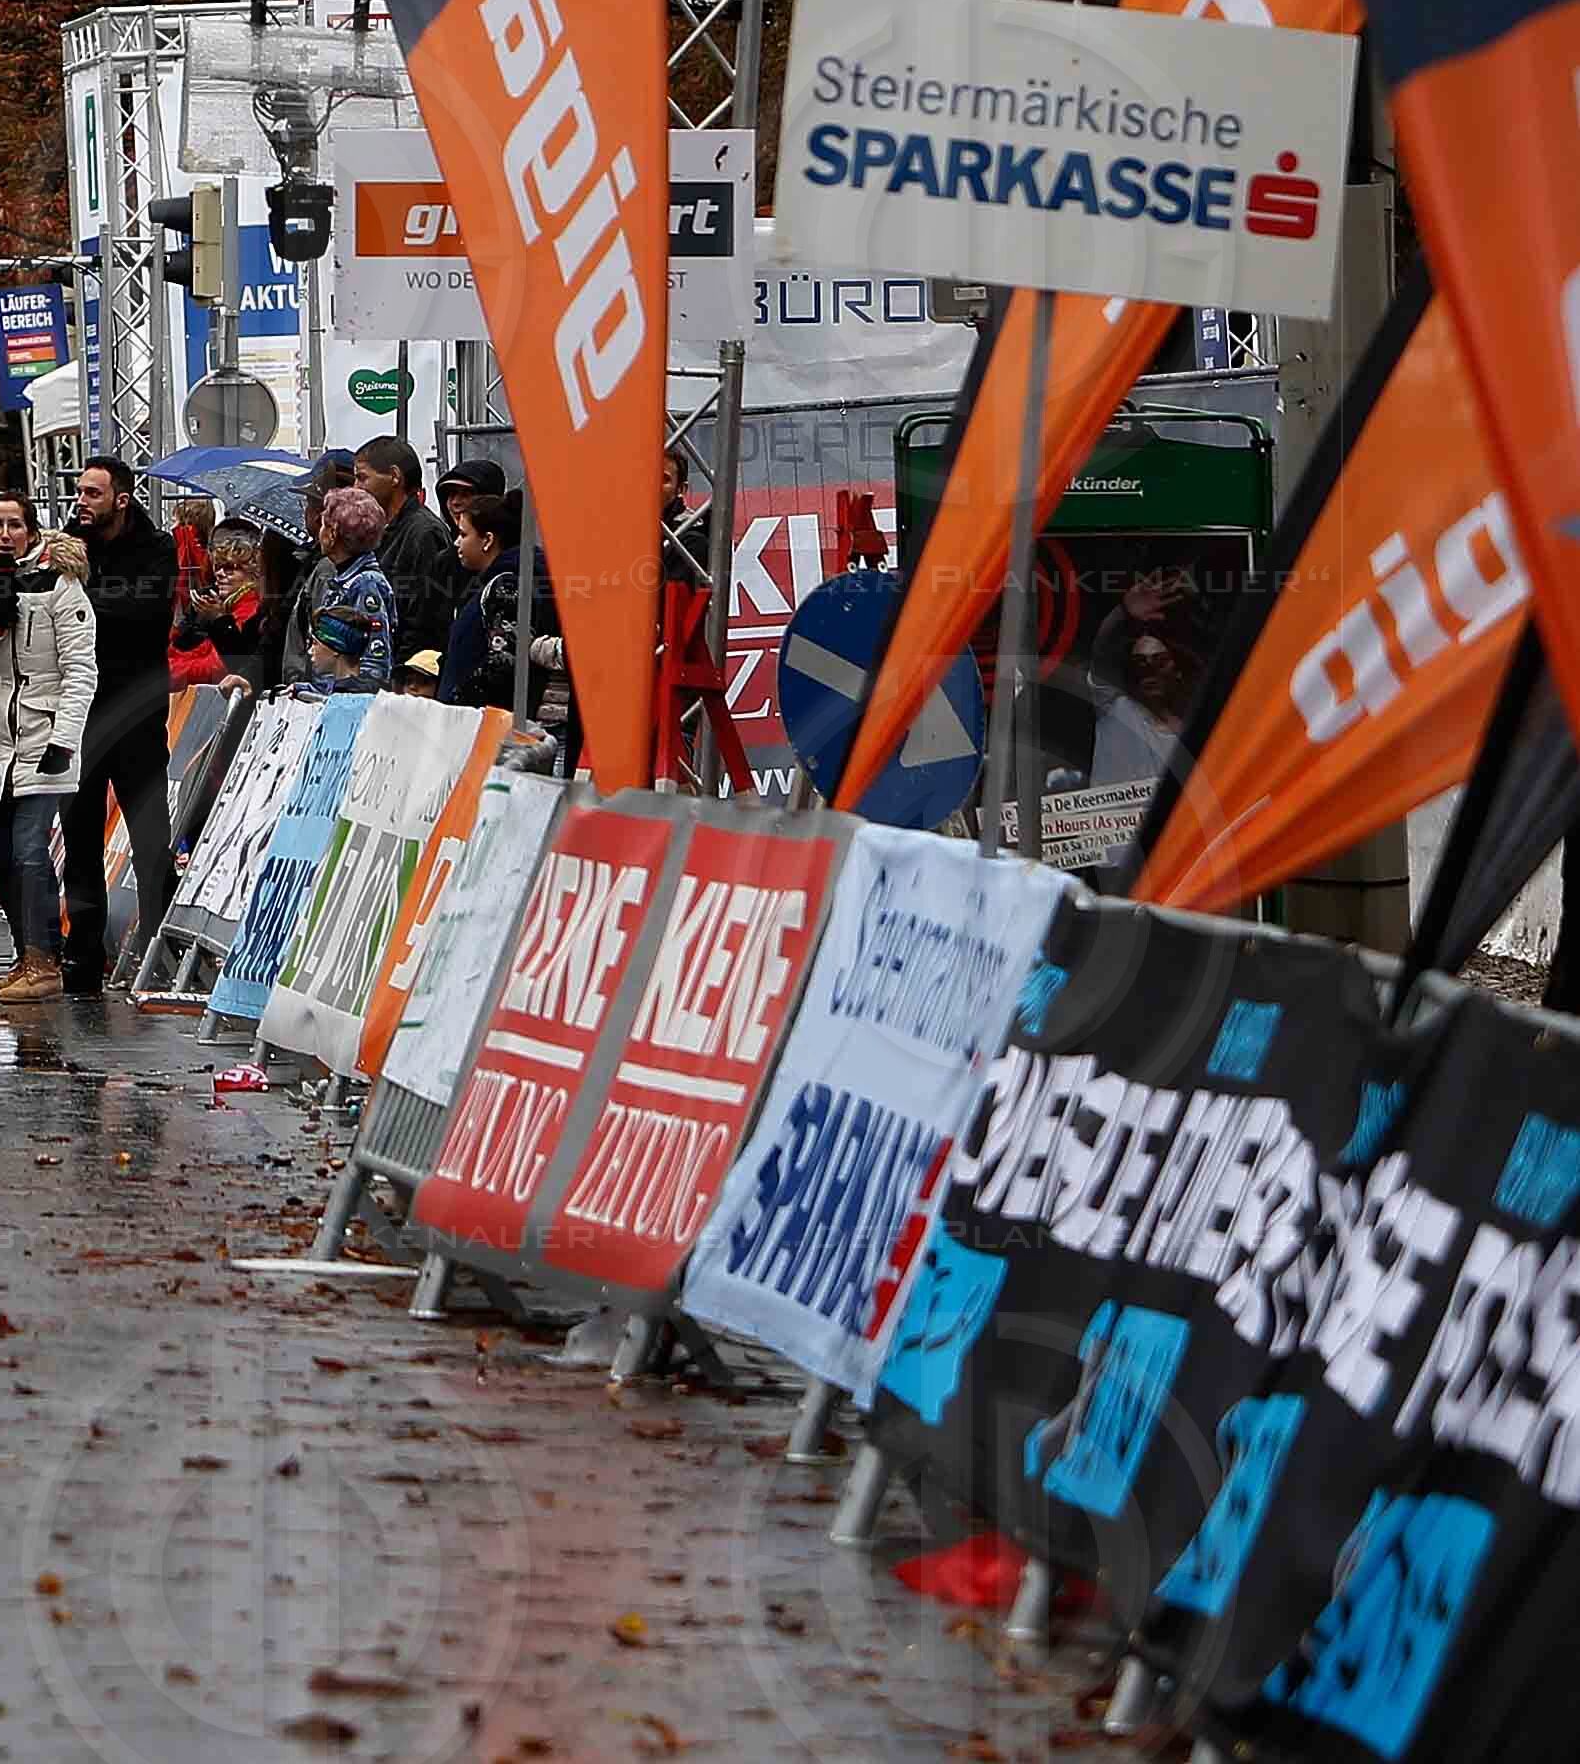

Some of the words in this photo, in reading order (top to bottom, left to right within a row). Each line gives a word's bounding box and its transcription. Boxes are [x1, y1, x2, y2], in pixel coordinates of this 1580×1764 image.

[811, 54, 1242, 149] Steiermärkische
[803, 123, 1236, 231] SPARKASSE
[405, 271, 441, 290] WO
[0, 293, 53, 313] LÄUFER-
[2, 311, 54, 331] BEREICH
[1066, 475, 1141, 491] künder
[1054, 797, 1071, 813] De
[1073, 785, 1153, 810] Keersmaeker
[1056, 817, 1091, 834] Hours
[1114, 814, 1137, 831] you
